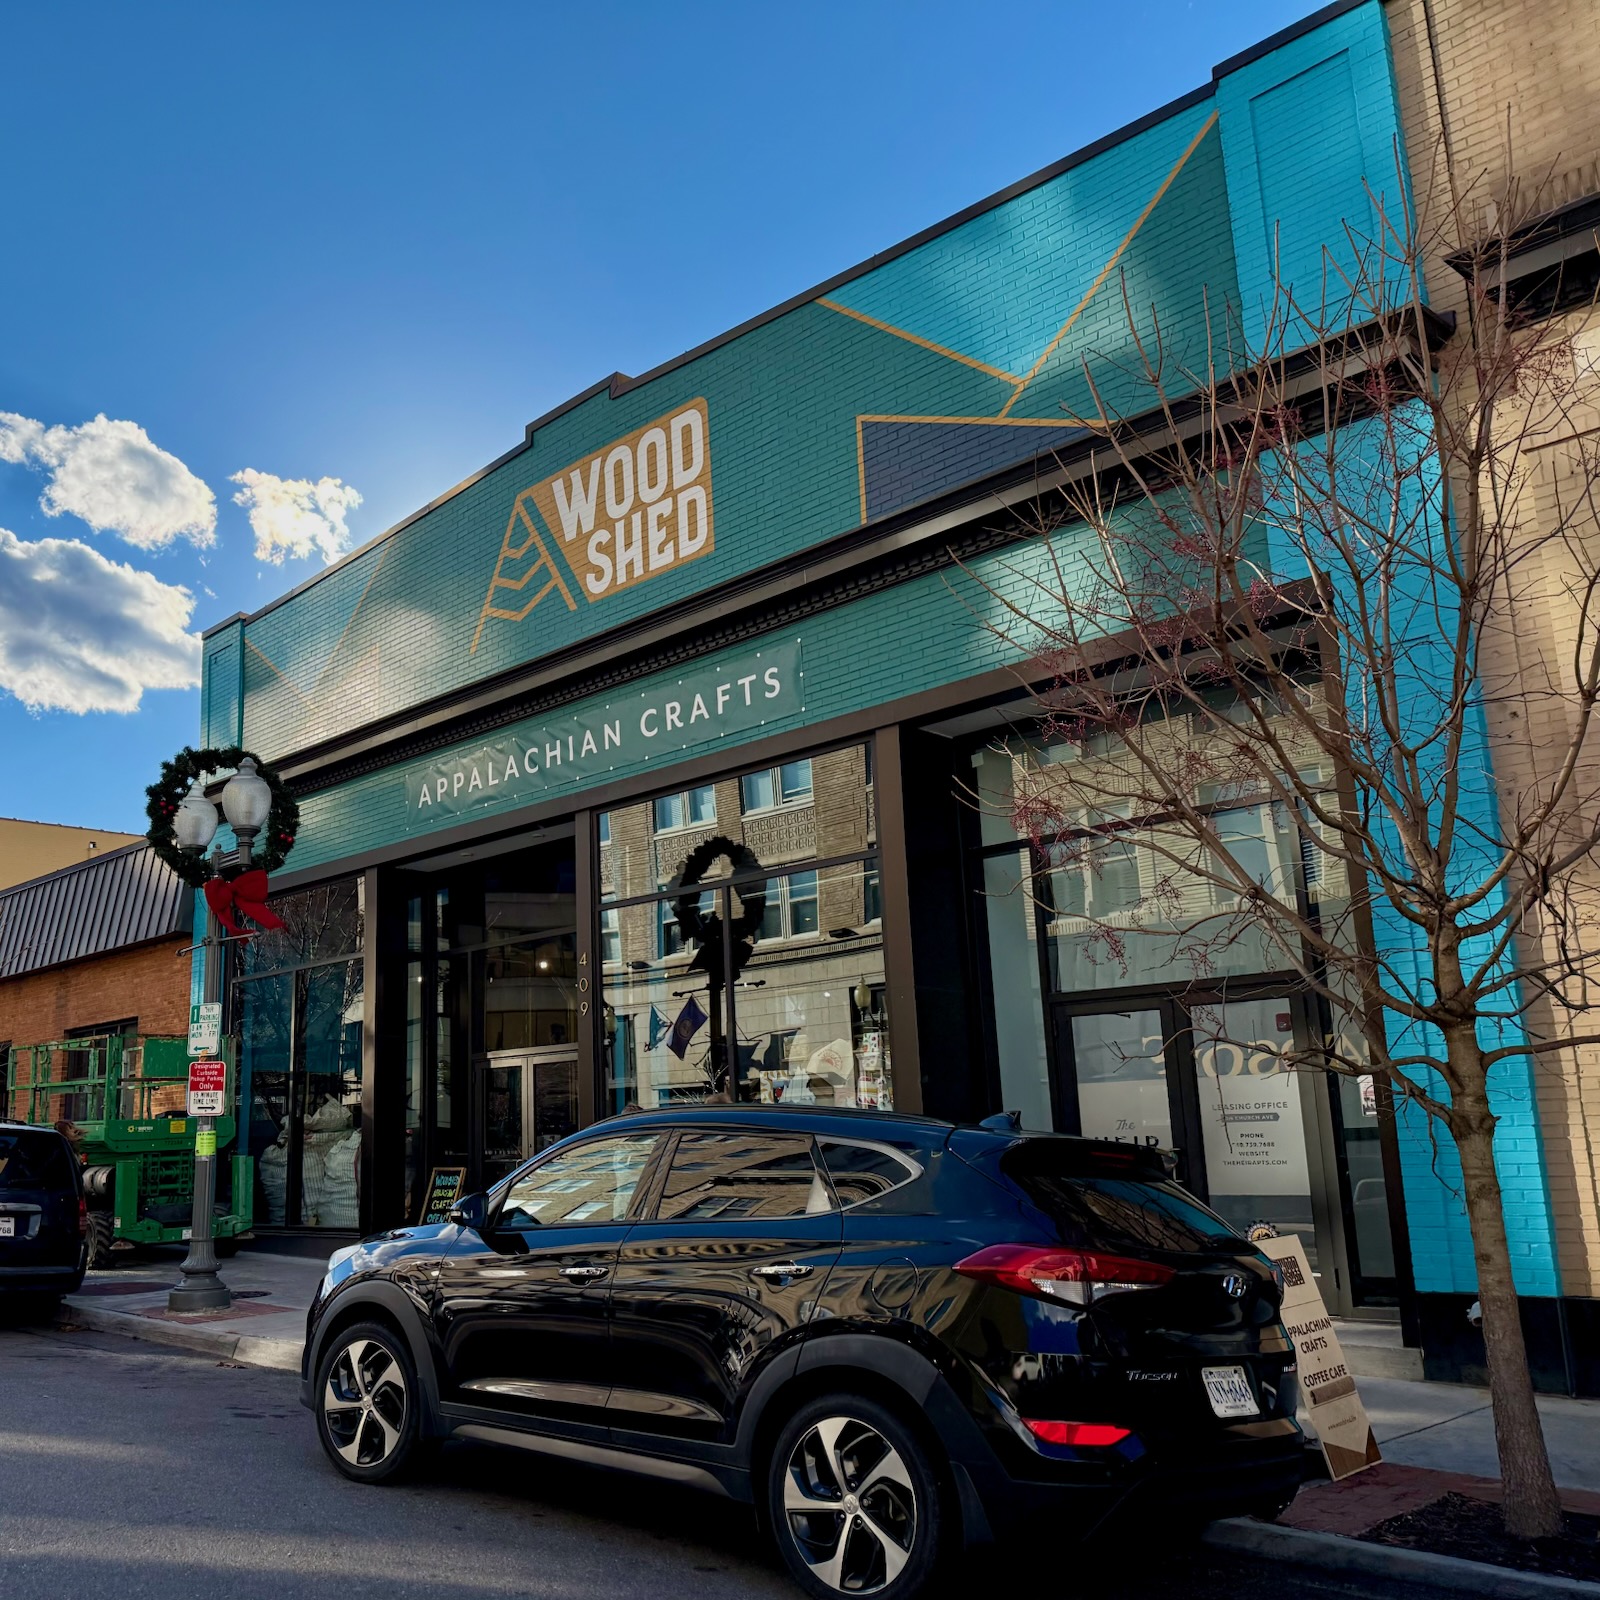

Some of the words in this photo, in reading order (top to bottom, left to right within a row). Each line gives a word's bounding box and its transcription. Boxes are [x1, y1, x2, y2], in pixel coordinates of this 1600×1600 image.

[551, 408, 704, 542] WOOD
[585, 485, 708, 594] SHED
[418, 719, 623, 809] APPALACHIAN
[640, 666, 781, 738] CRAFTS
[579, 951, 589, 1017] 409
[200, 1014, 219, 1022] PARKING
[208, 1030, 216, 1038] FRI
[198, 1082, 214, 1090] Only
[207, 1075, 224, 1083] Parking
[1211, 1102, 1251, 1111] LEASING
[1253, 1101, 1289, 1110] OFFICE
[1115, 1119, 1136, 1131] The
[1287, 1316, 1332, 1339] PPALACHIAN
[1300, 1336, 1328, 1354] CRAFTS
[1303, 1369, 1330, 1388] COFFEE
[1328, 1364, 1348, 1380] CAFE
